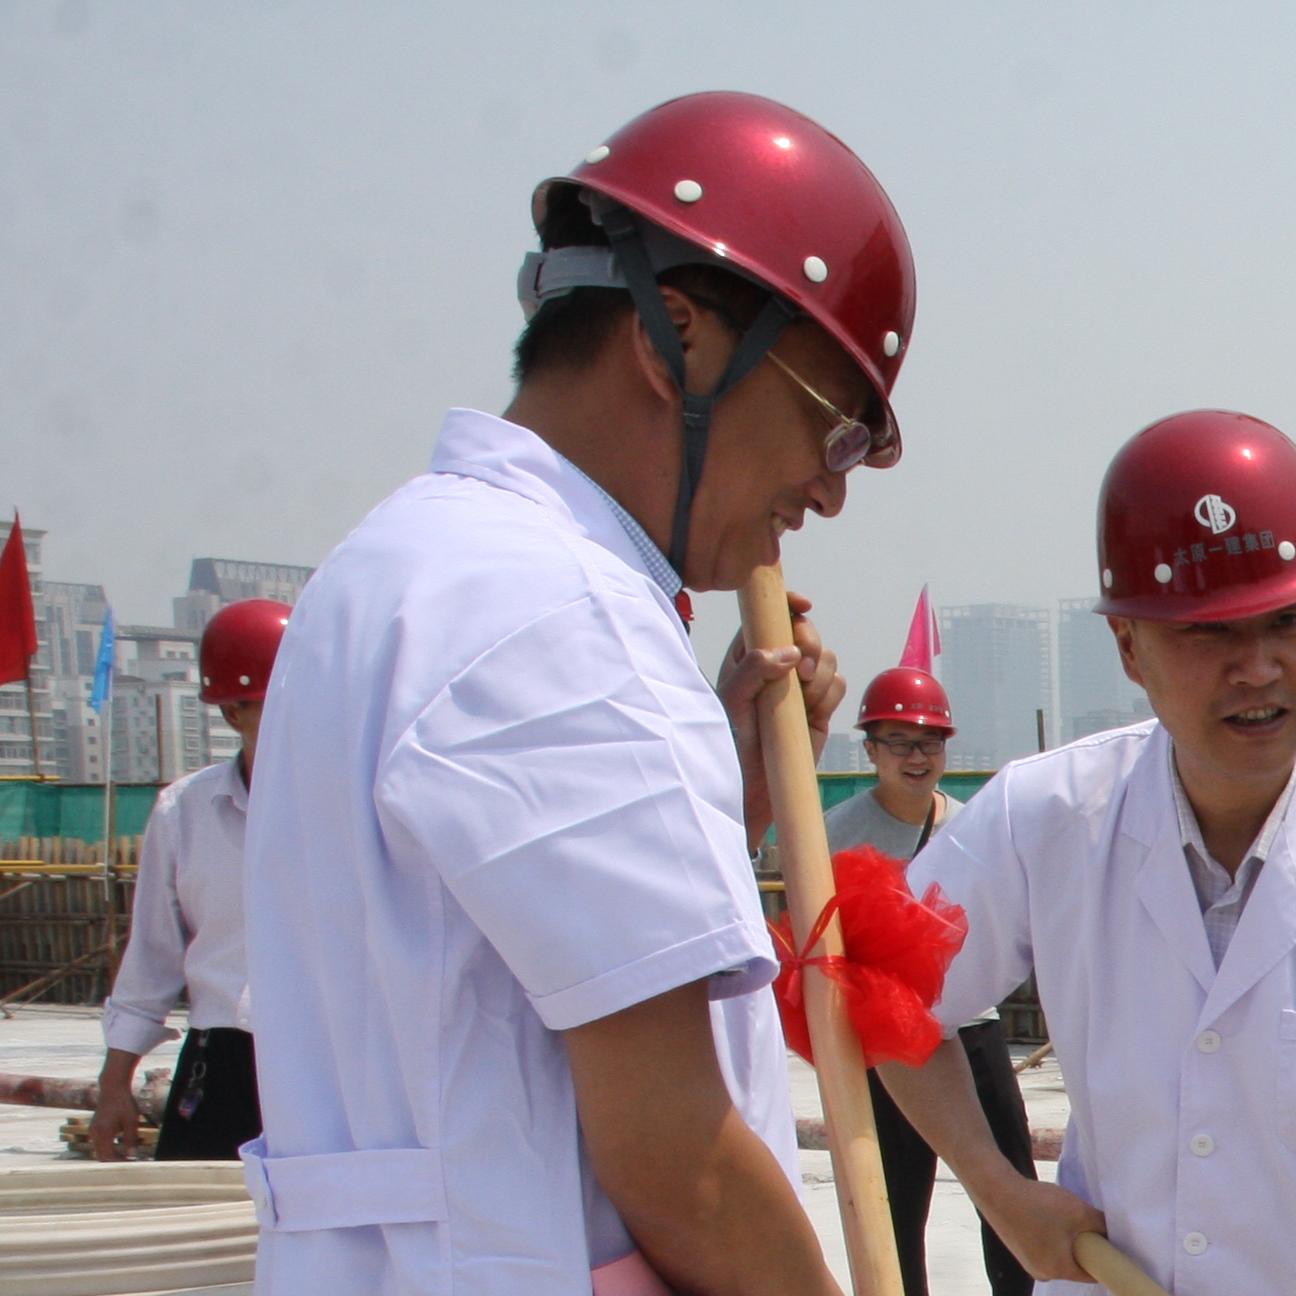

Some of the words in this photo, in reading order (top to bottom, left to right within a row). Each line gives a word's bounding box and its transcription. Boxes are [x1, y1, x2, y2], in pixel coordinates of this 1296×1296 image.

[1173, 529, 1277, 566] 太原一建集团
